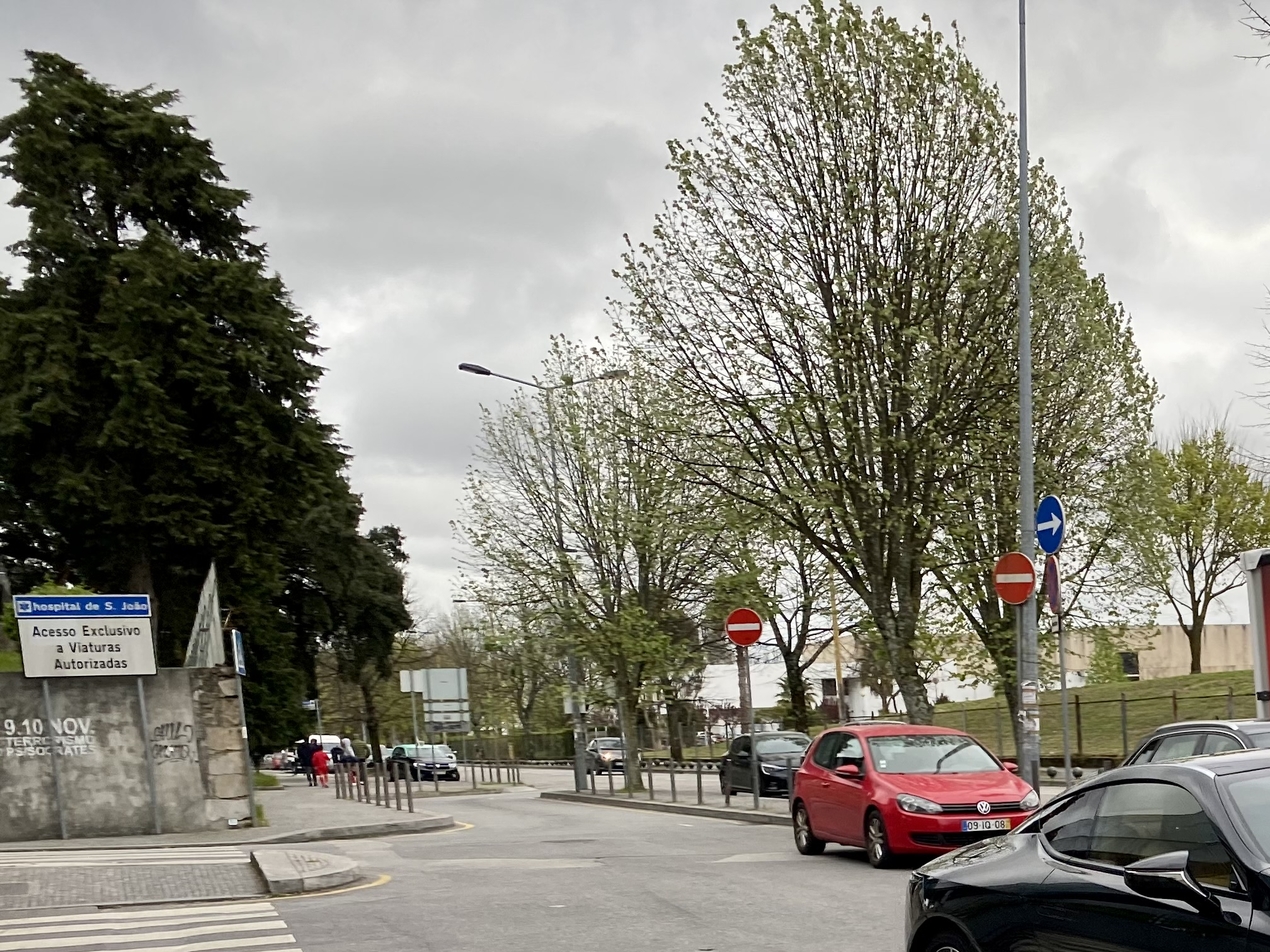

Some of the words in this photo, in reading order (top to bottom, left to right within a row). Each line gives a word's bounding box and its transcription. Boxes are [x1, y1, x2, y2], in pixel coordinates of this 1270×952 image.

[32, 602, 81, 612] hospital
[85, 602, 99, 611] de
[105, 602, 117, 611] S.
[121, 602, 149, 611] João
[32, 626, 77, 637] Acesso
[82, 625, 141, 637] Exclusivo
[56, 644, 64, 653] a
[69, 642, 121, 653] Viaturas
[54, 658, 128, 670] Autorizadas
